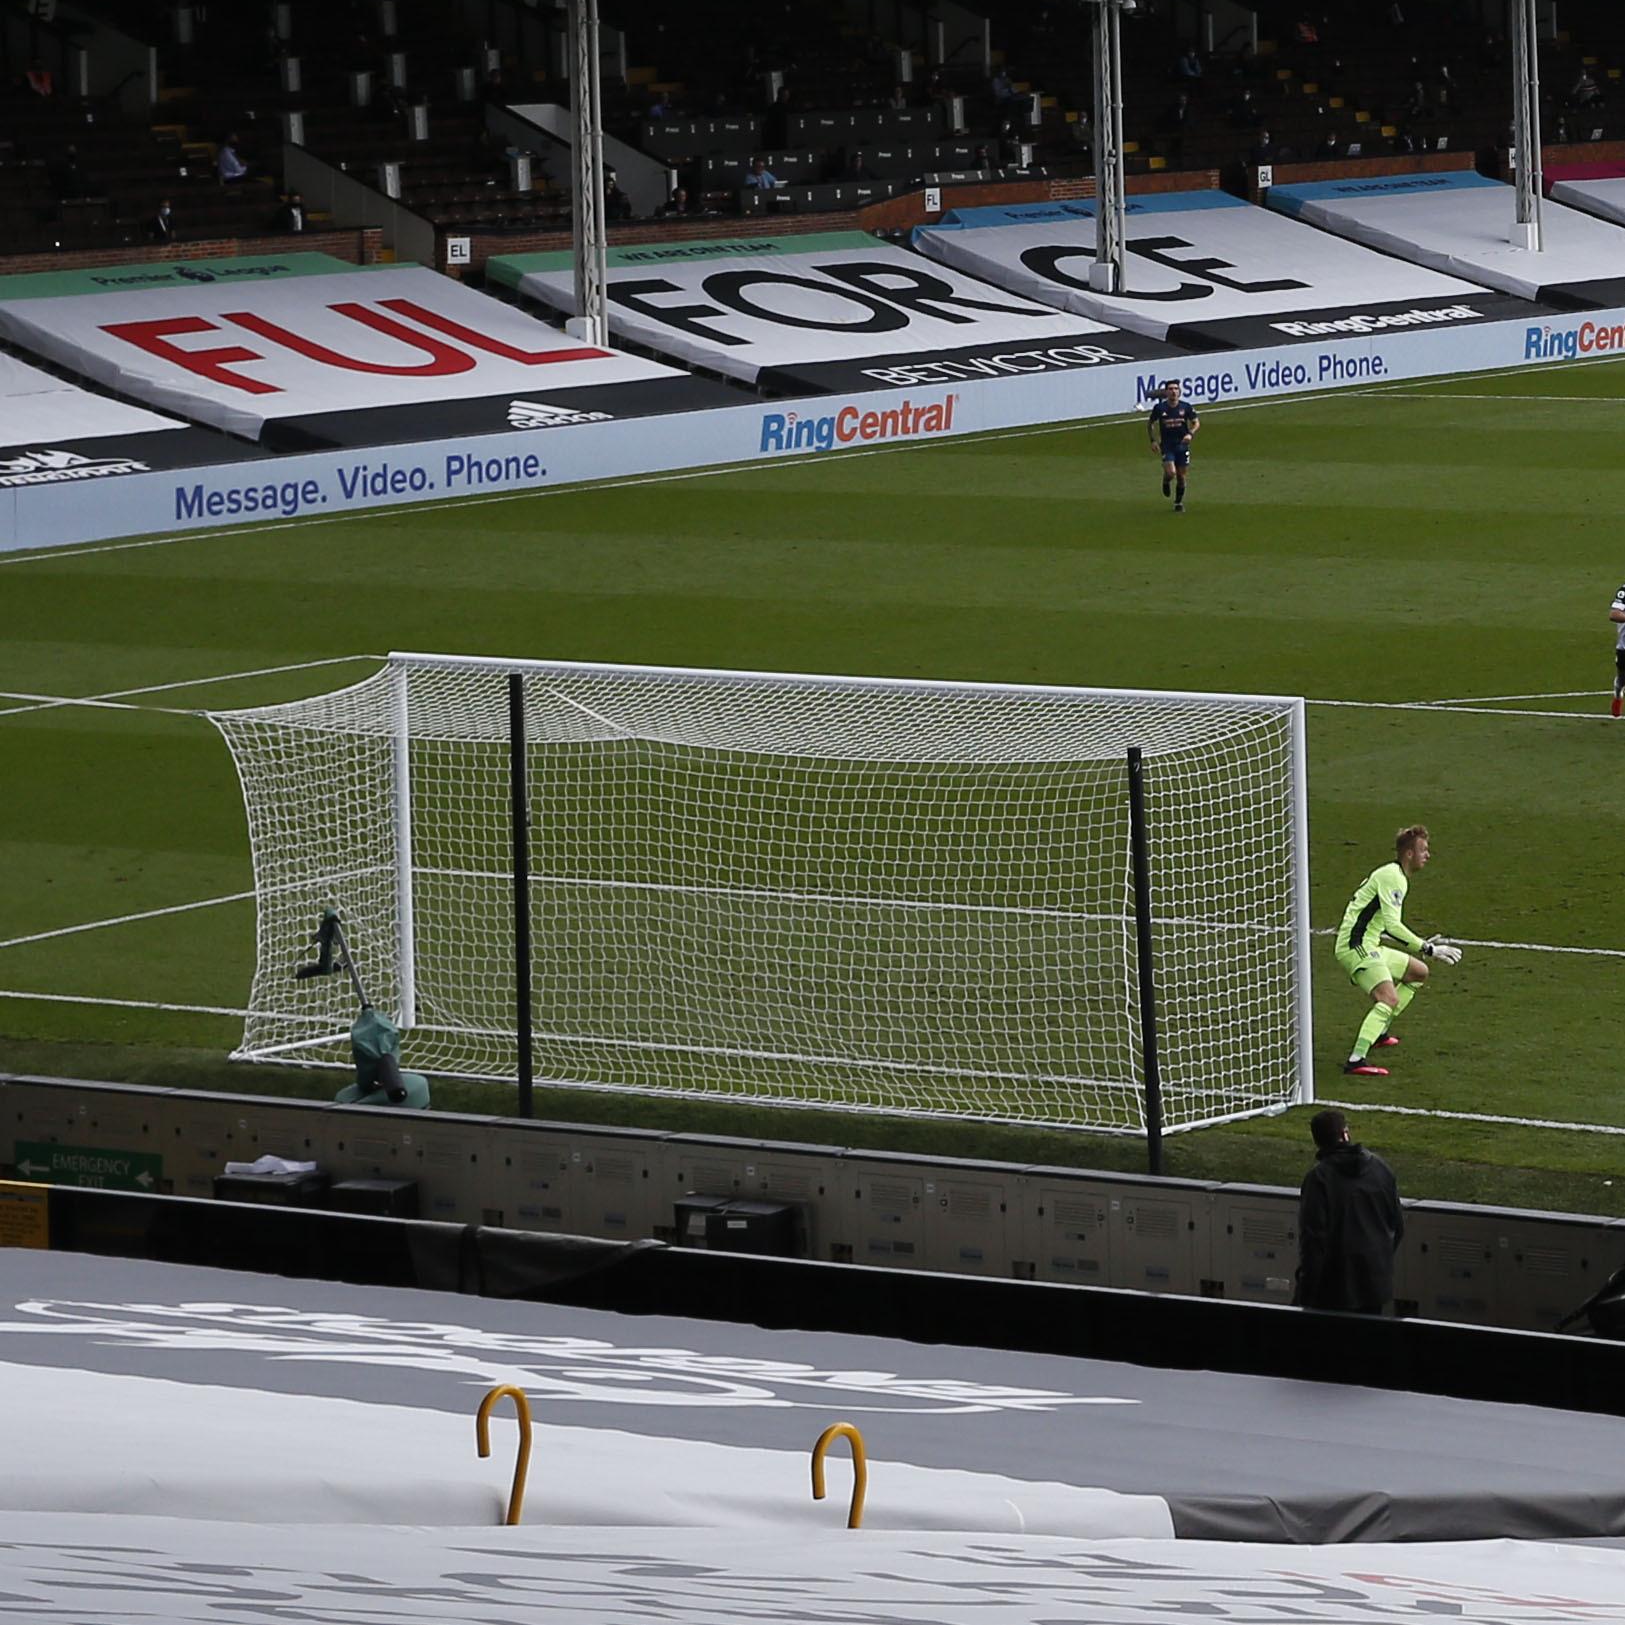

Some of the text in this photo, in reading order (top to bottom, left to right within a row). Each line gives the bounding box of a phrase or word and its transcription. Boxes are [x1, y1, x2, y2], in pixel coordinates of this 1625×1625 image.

[1259, 169, 1271, 184] GL
[927, 194, 939, 207] FL
[450, 244, 468, 259] EL
[618, 243, 781, 263] WE ARE ONE TEAM
[1269, 304, 1484, 337] RingCentral
[96, 297, 619, 396] FUL
[860, 345, 1135, 388] BETVICTOR
[1245, 361, 1314, 391] Video.
[1318, 353, 1390, 383] Phone.
[759, 394, 954, 453] RingCentral
[174, 452, 548, 520] Message. Video. Phone.
[52, 1152, 132, 1175] EMERGENCY
[79, 1173, 105, 1188] EXIT
